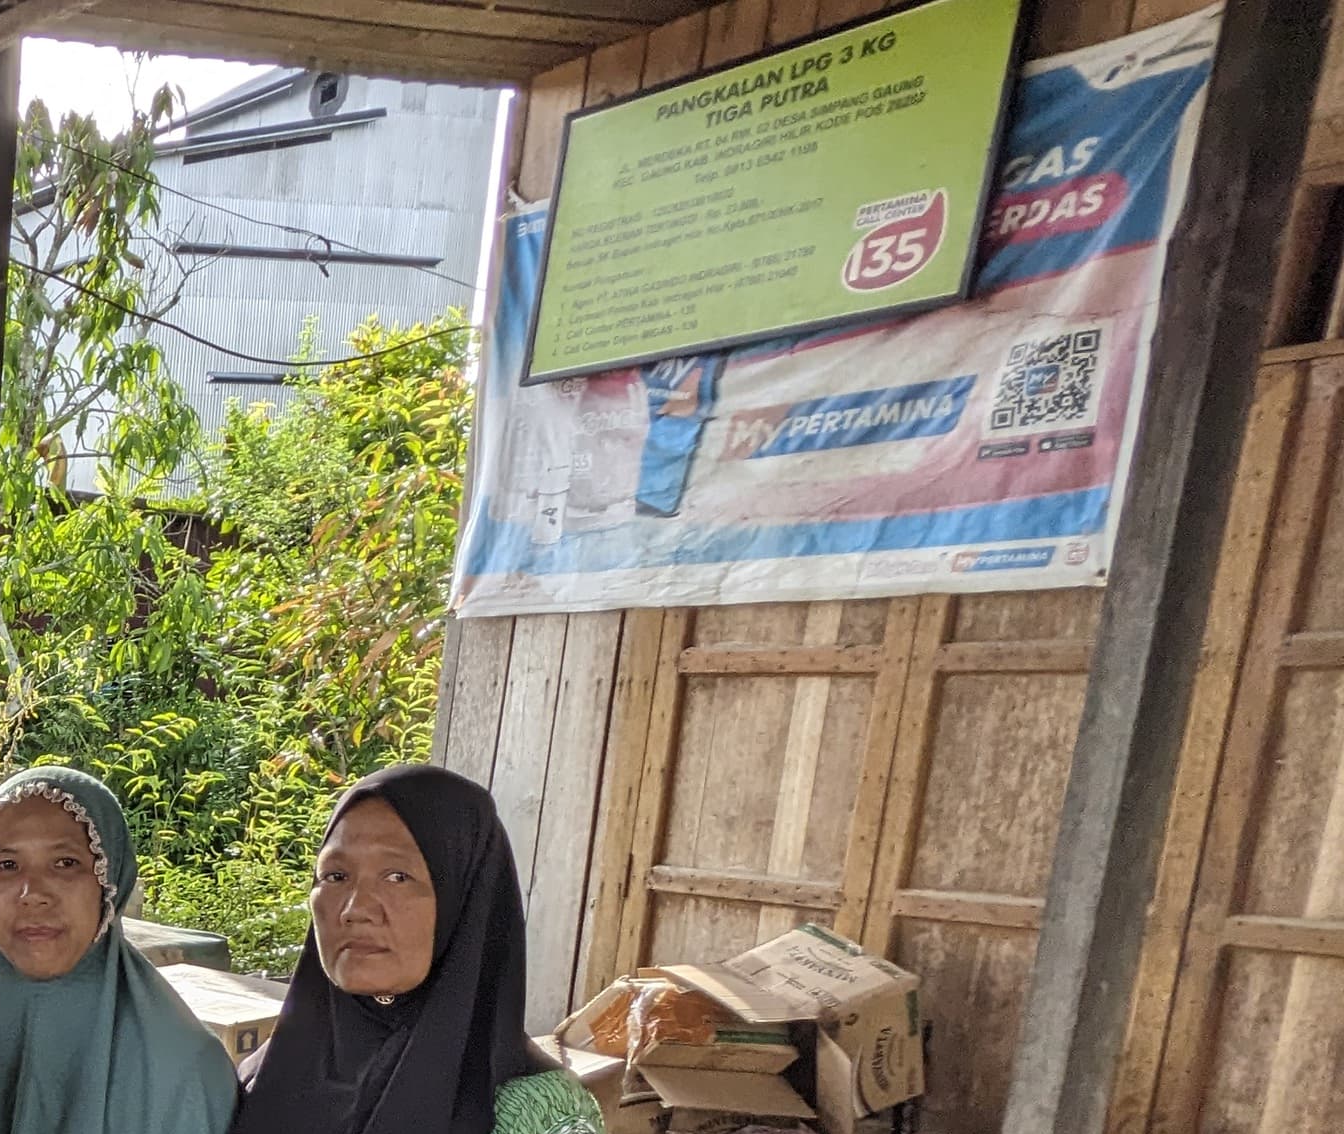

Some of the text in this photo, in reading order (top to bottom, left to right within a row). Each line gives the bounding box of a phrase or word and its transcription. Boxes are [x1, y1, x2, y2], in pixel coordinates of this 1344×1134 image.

[656, 31, 898, 123] PANGKALAN LPG 3 KG
[705, 77, 830, 129] TIGA PUTRA
[773, 111, 807, 132] DESA
[810, 92, 870, 119] SIMPANG
[872, 76, 925, 101] GAUNG
[779, 124, 813, 145] HILIR
[816, 113, 851, 133] KODE
[855, 102, 882, 122] POS
[857, 204, 926, 227] CALL CENTER
[859, 192, 929, 216] PERTAMINA
[848, 228, 928, 281] 135
